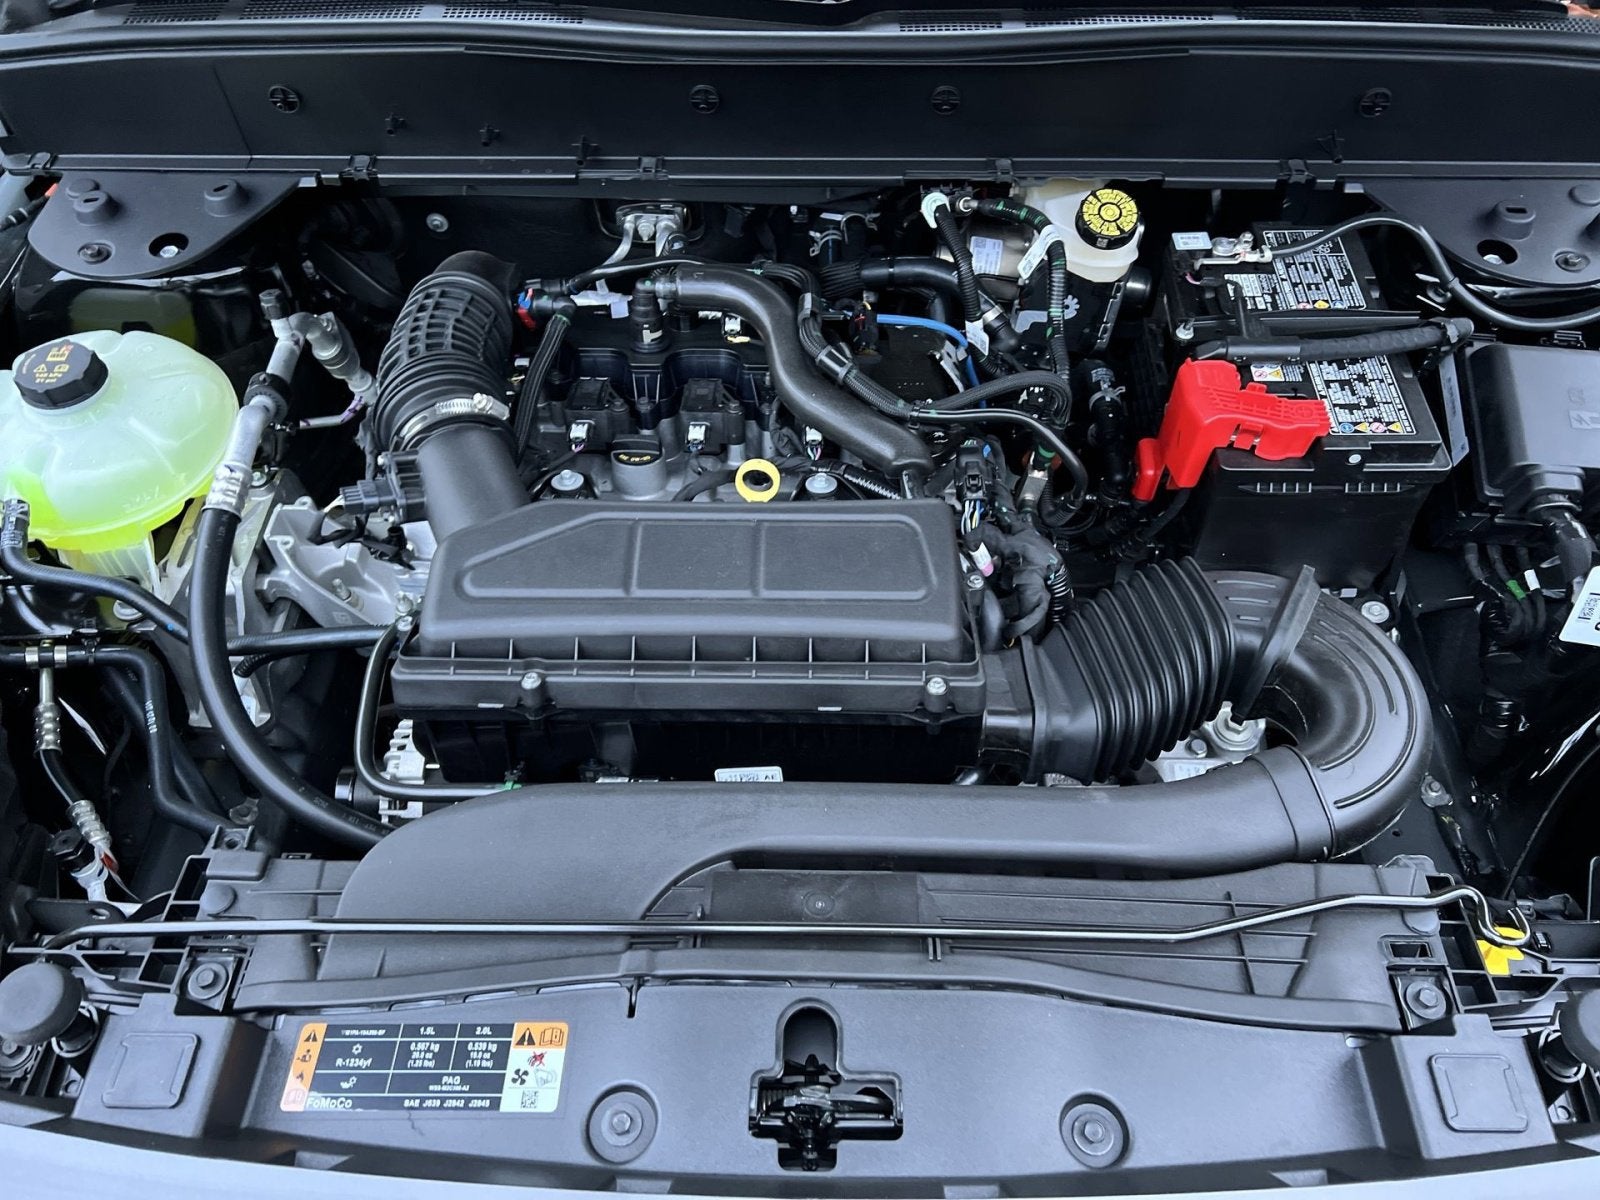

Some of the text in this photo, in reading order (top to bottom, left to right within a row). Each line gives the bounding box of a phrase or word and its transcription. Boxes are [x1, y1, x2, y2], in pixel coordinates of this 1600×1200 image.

[419, 1027, 435, 1035] 1.5L
[475, 1027, 492, 1035] 2.0L
[410, 1042, 440, 1053] 0.567 kg
[488, 1042, 498, 1053] kg
[335, 1058, 373, 1068] R-1234yf
[441, 1076, 461, 1084] PAG
[305, 1097, 353, 1109] FoMoCo
[403, 1099, 421, 1107] SAE
[422, 1099, 441, 1107] J639
